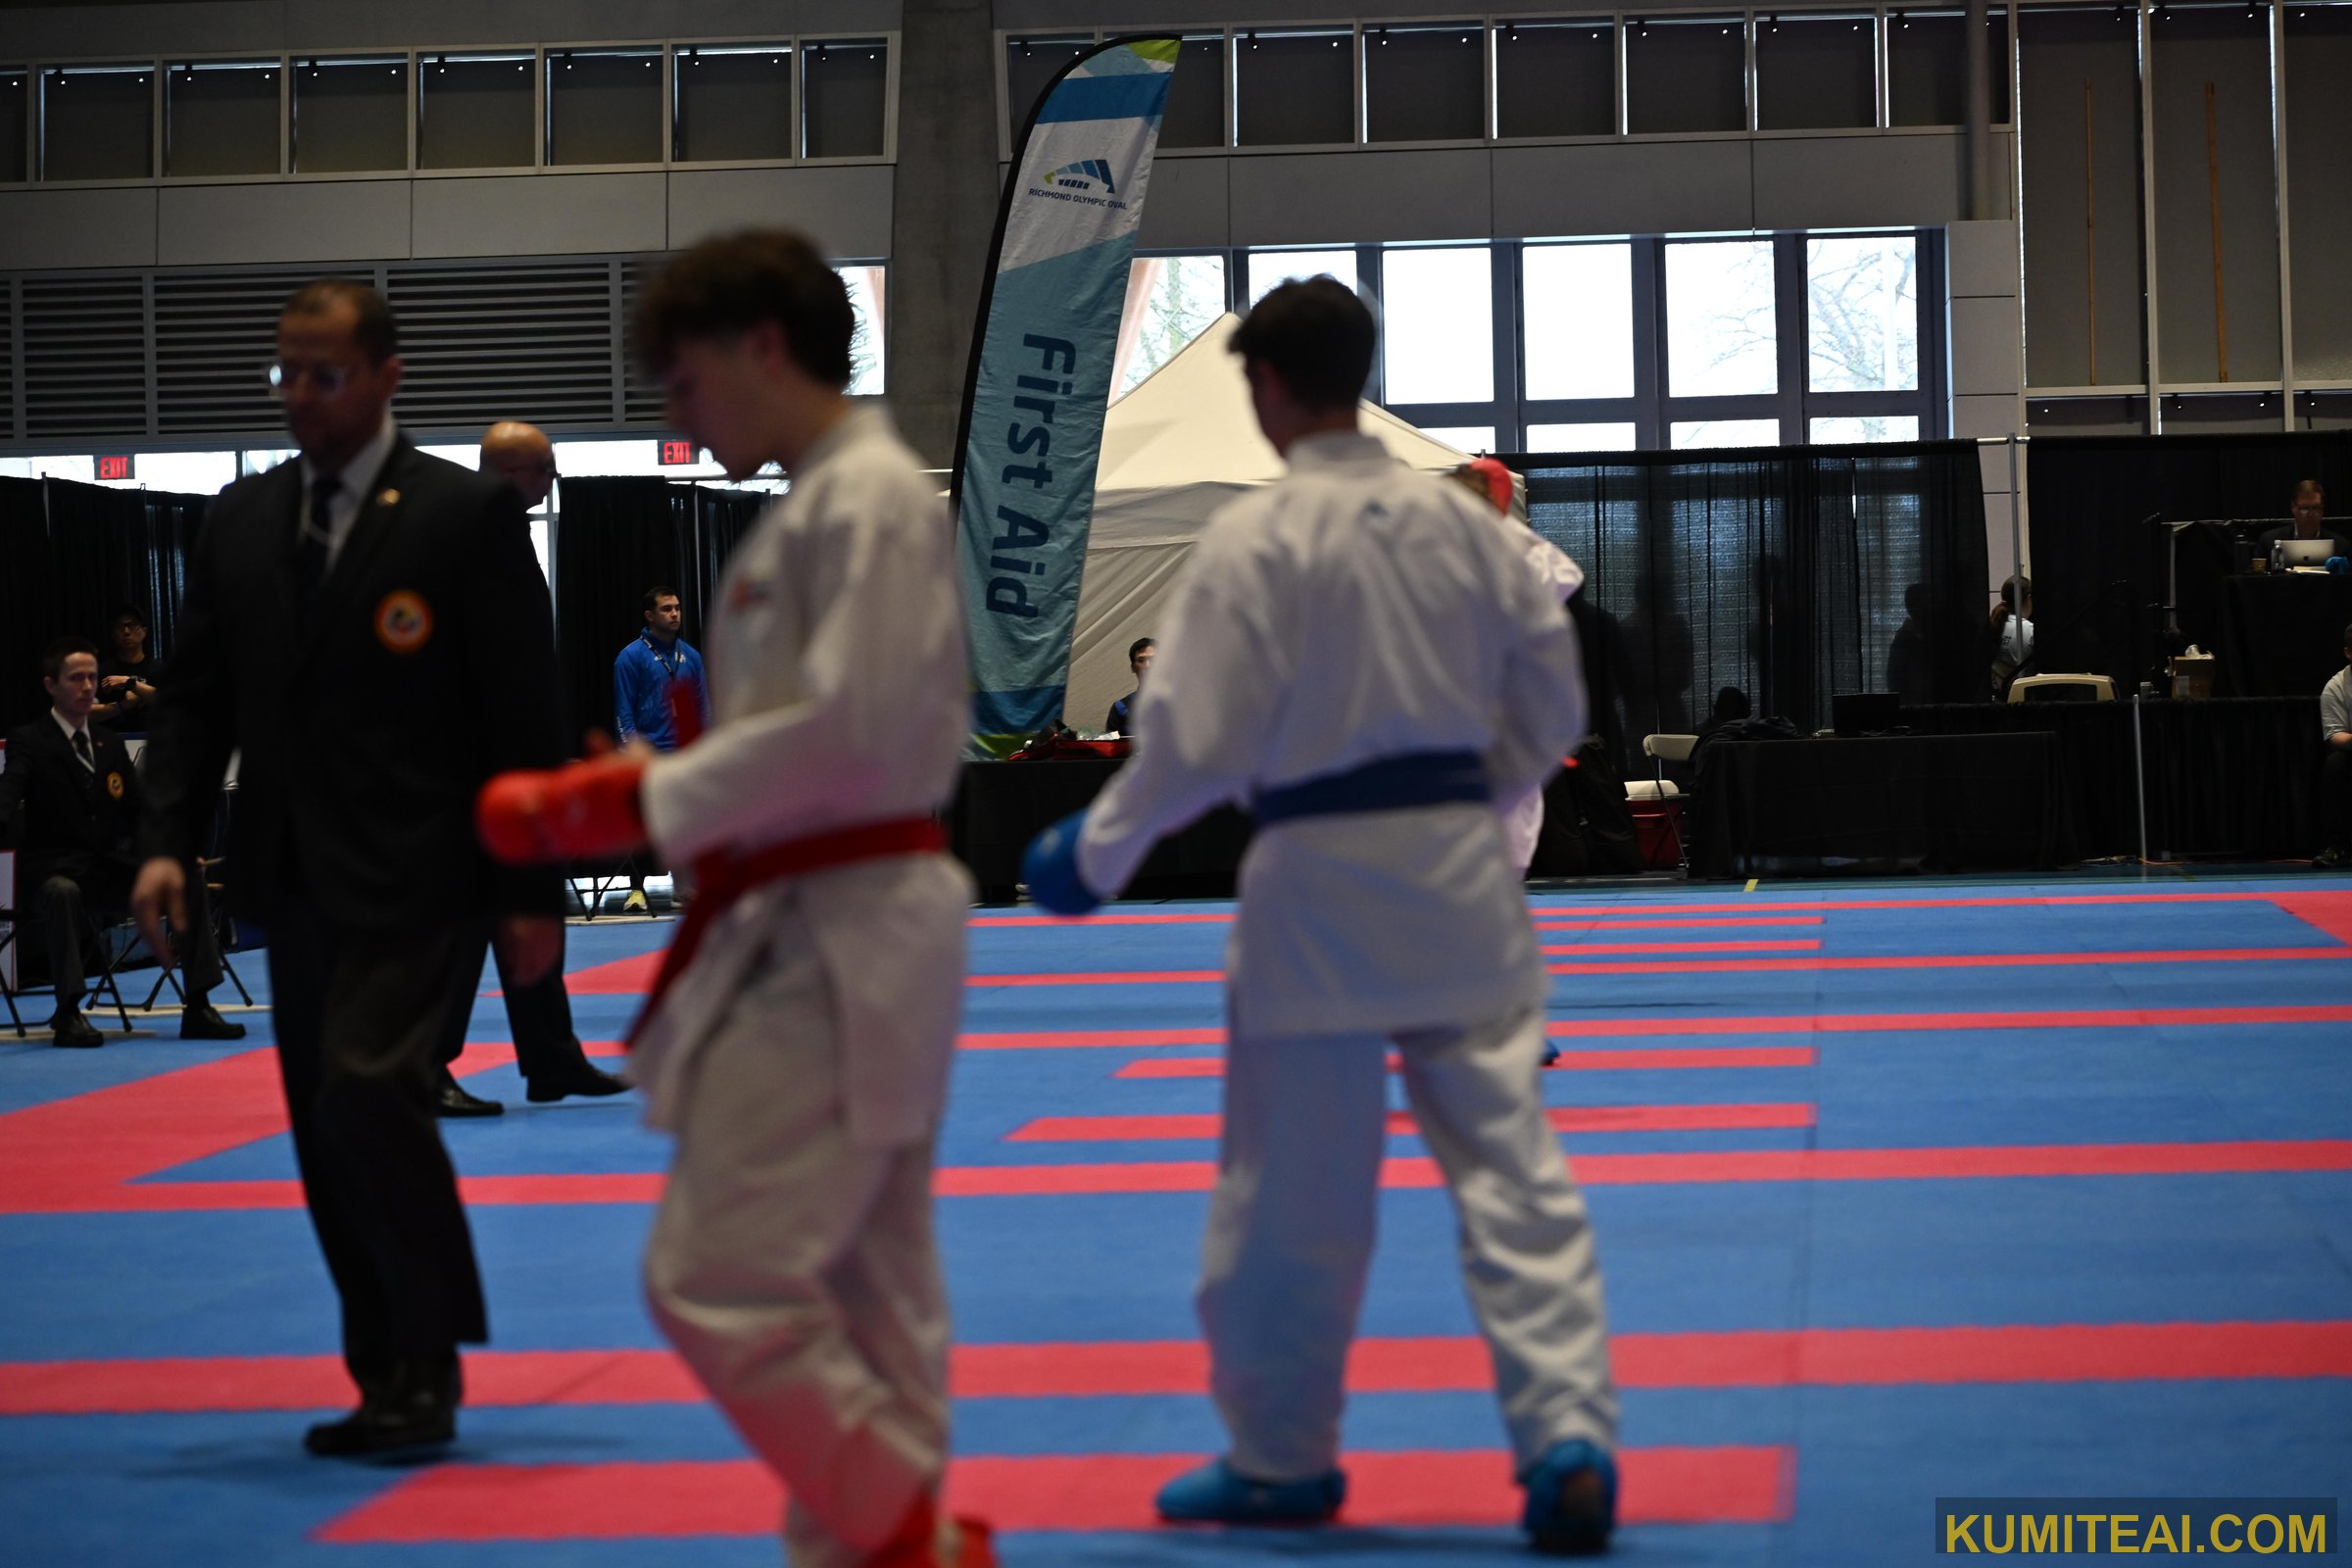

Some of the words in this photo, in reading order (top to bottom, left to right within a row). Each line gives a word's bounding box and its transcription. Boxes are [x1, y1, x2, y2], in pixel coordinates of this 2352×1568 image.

[1028, 188, 1071, 201] RICHMOND
[1073, 195, 1106, 207] OLYMPIC
[1107, 200, 1128, 210] OVAL
[1002, 333, 1076, 488] First
[663, 441, 691, 464] EXIT
[100, 456, 128, 479] EXIT
[986, 505, 1050, 617] Aid
